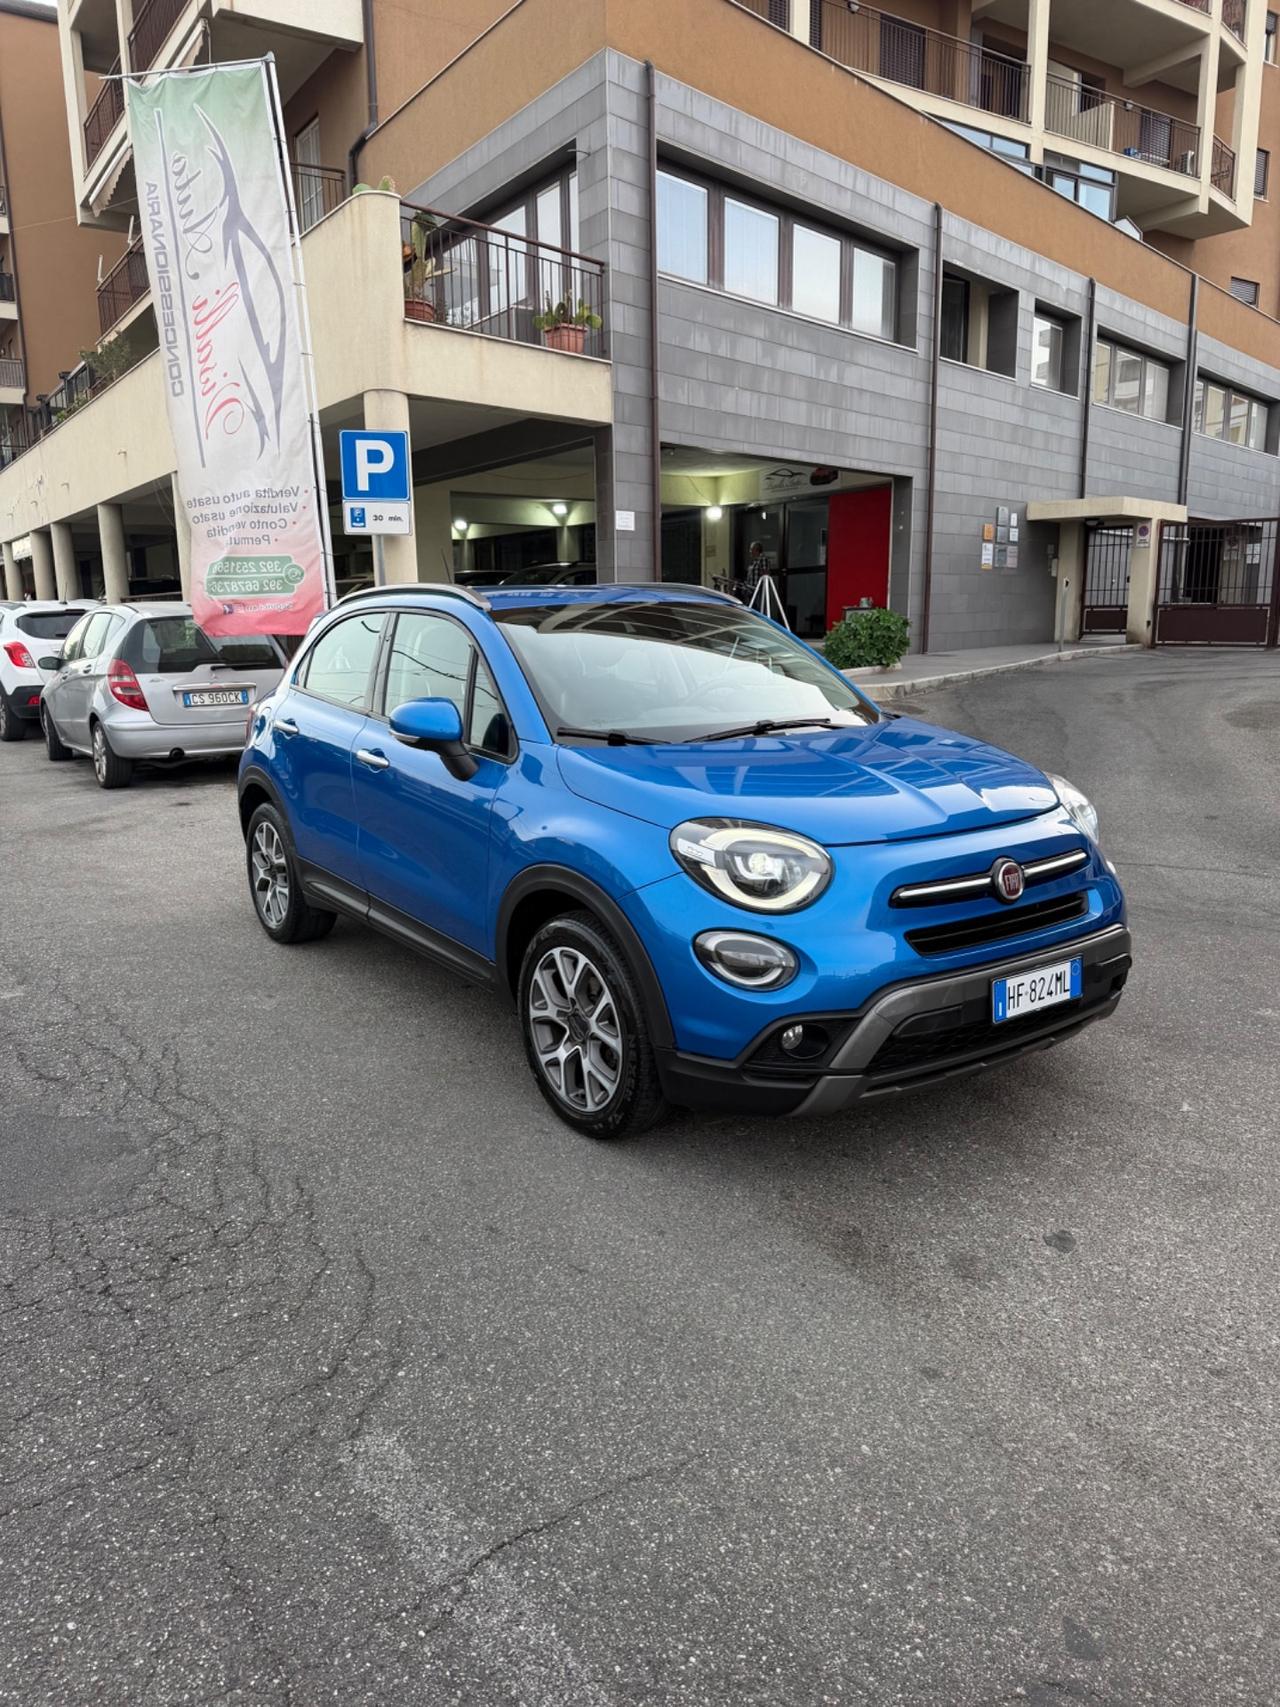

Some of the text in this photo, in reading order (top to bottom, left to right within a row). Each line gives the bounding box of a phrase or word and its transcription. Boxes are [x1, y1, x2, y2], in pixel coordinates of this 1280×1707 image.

[355, 440, 395, 492] P
[192, 692, 241, 704] CS 960CK
[1004, 873, 1019, 892] FIAT
[1008, 982, 1025, 1010] HF
[1029, 970, 1070, 1004] 824ML
